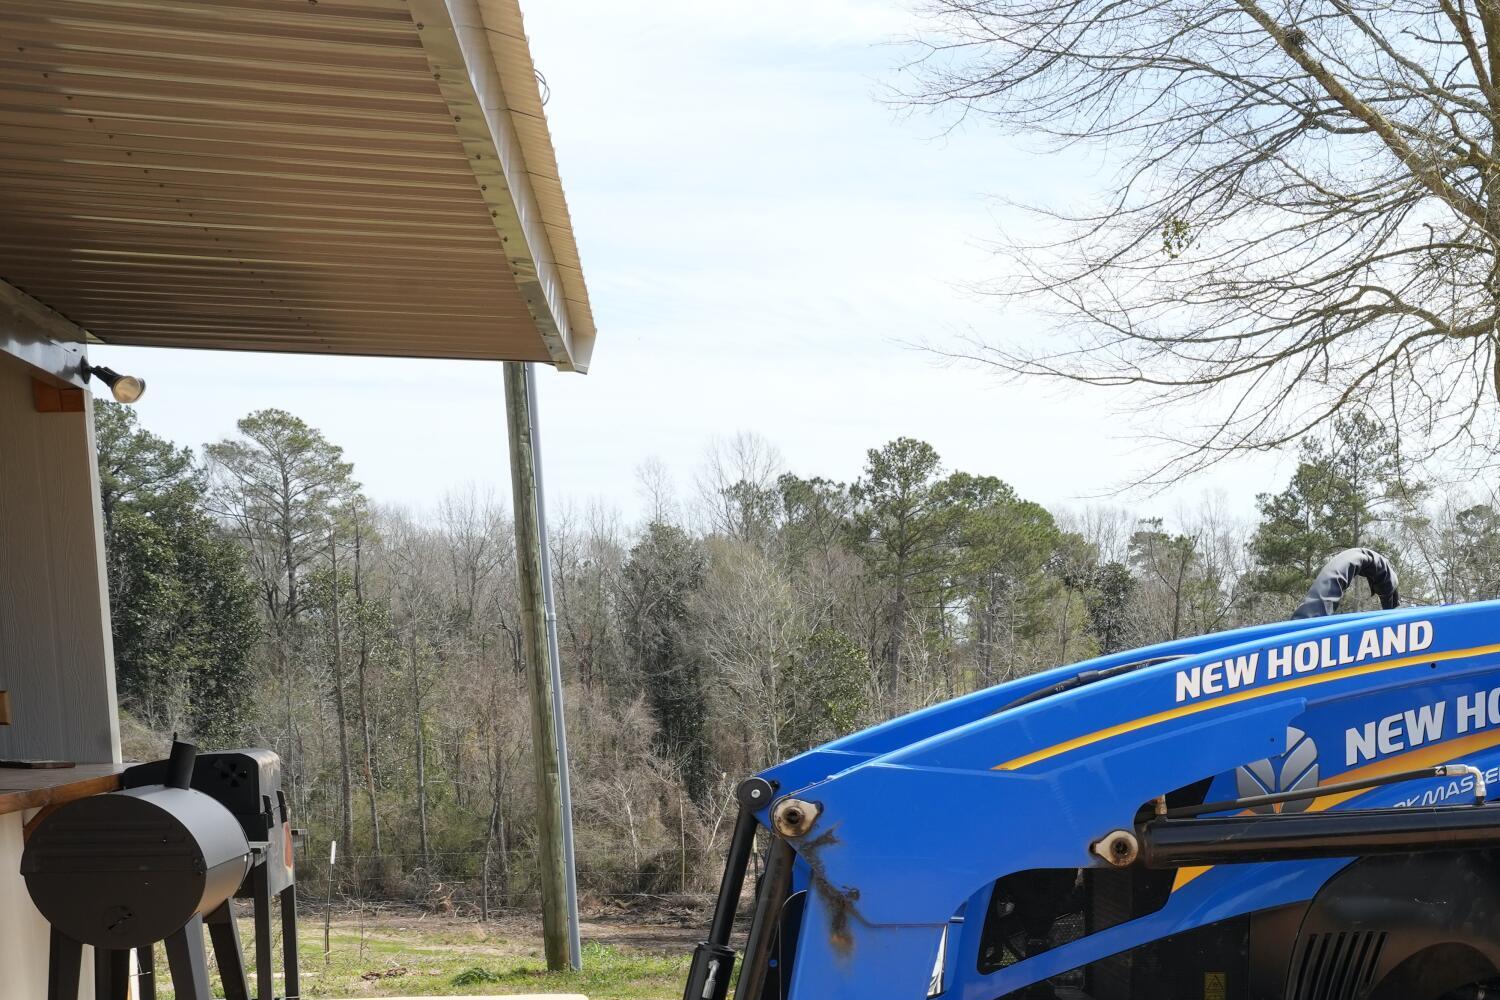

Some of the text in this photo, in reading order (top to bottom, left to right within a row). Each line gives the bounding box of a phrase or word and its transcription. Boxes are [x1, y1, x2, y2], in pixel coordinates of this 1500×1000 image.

[1176, 620, 1434, 702] NEW HOLLAND
[1345, 701, 1446, 766] NEW
